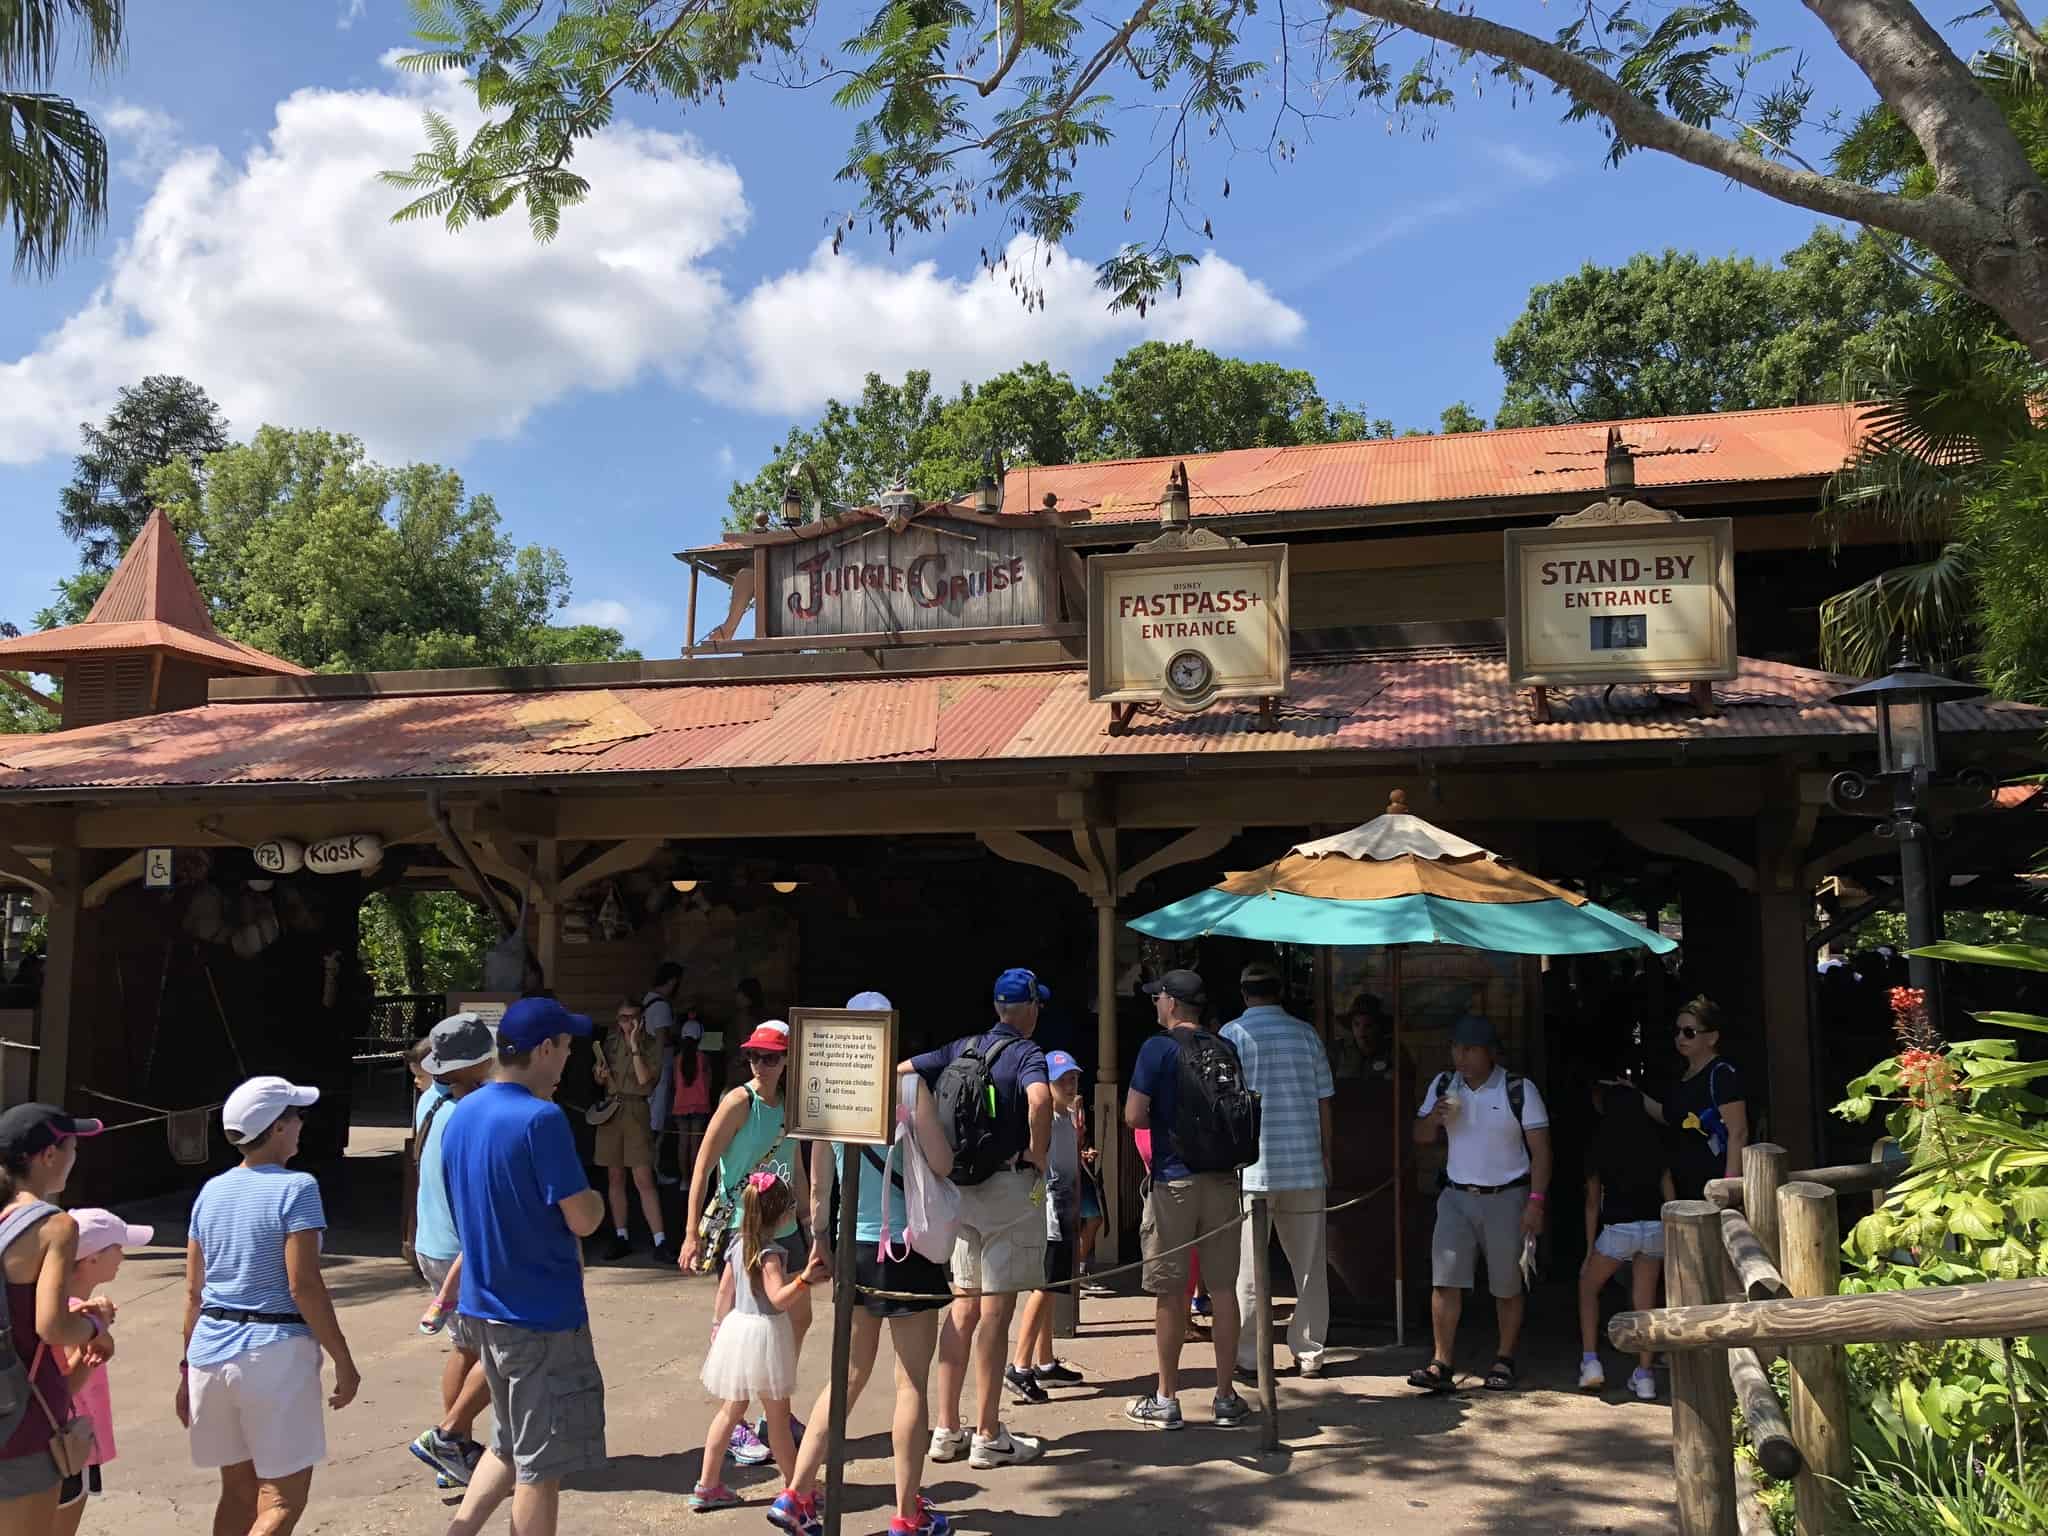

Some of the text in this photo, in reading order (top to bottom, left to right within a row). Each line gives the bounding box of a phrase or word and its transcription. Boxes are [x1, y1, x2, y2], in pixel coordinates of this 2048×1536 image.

[907, 554, 1025, 609] CRUISE
[1541, 555, 1695, 586] STAND-BY
[1119, 589, 1261, 618] FASTPASS+
[1565, 588, 1673, 609] ENTRANCE
[1142, 620, 1237, 639] ENTRANCE
[1611, 617, 1641, 640] 45
